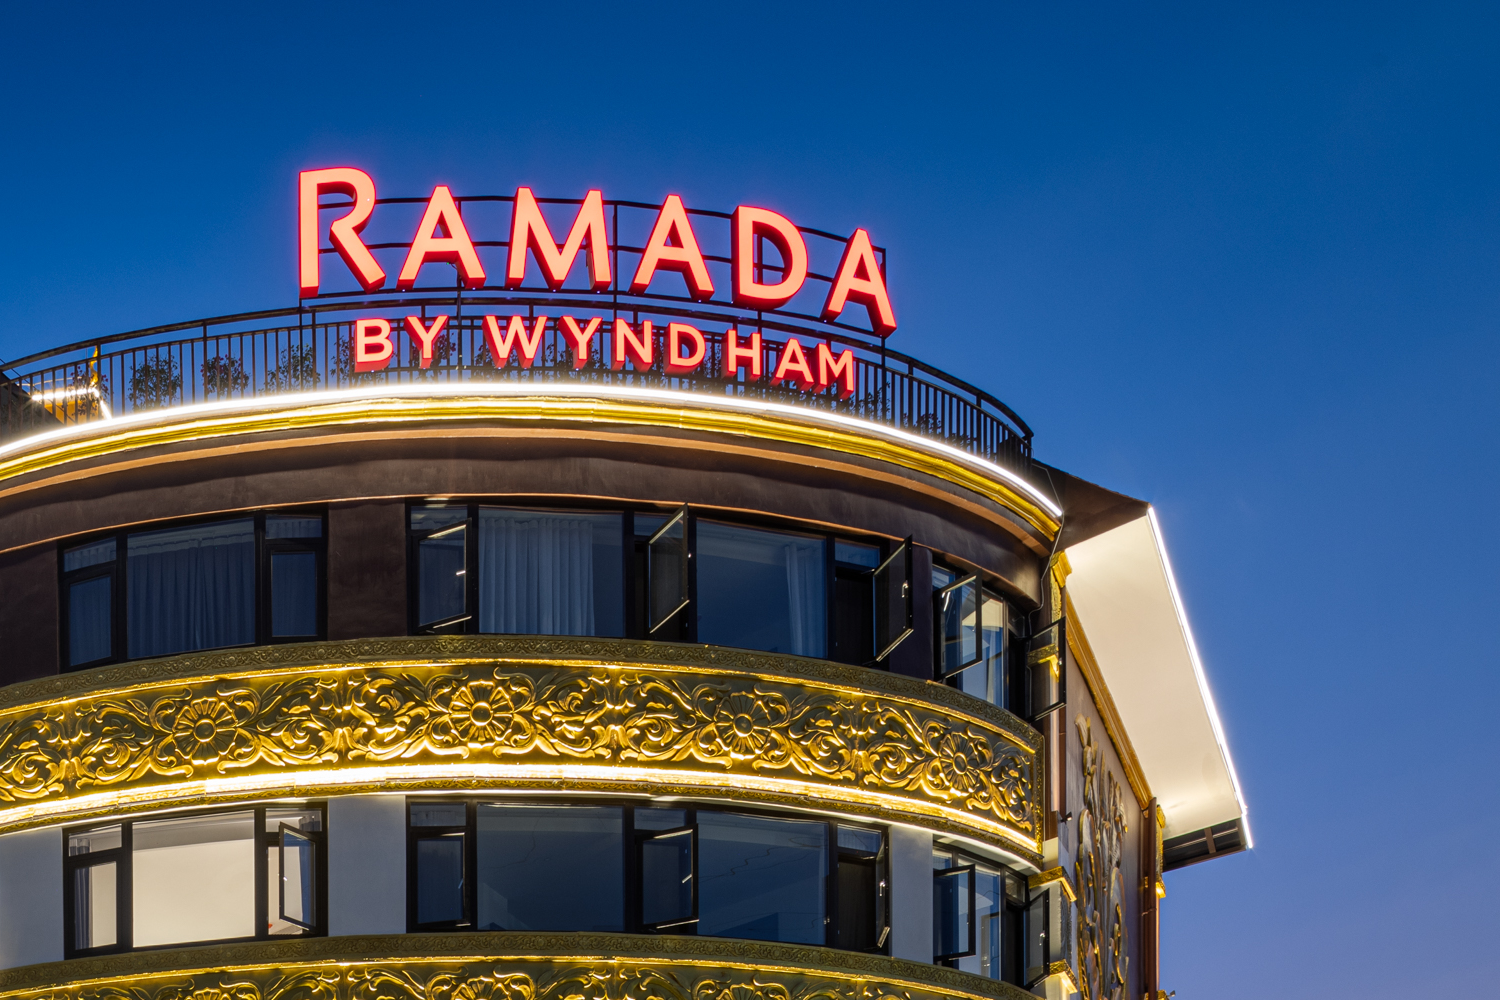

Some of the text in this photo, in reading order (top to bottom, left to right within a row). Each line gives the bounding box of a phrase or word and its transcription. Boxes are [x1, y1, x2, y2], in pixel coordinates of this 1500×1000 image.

[298, 166, 897, 338] RAMADA
[354, 315, 856, 399] BY WYNDHAM
